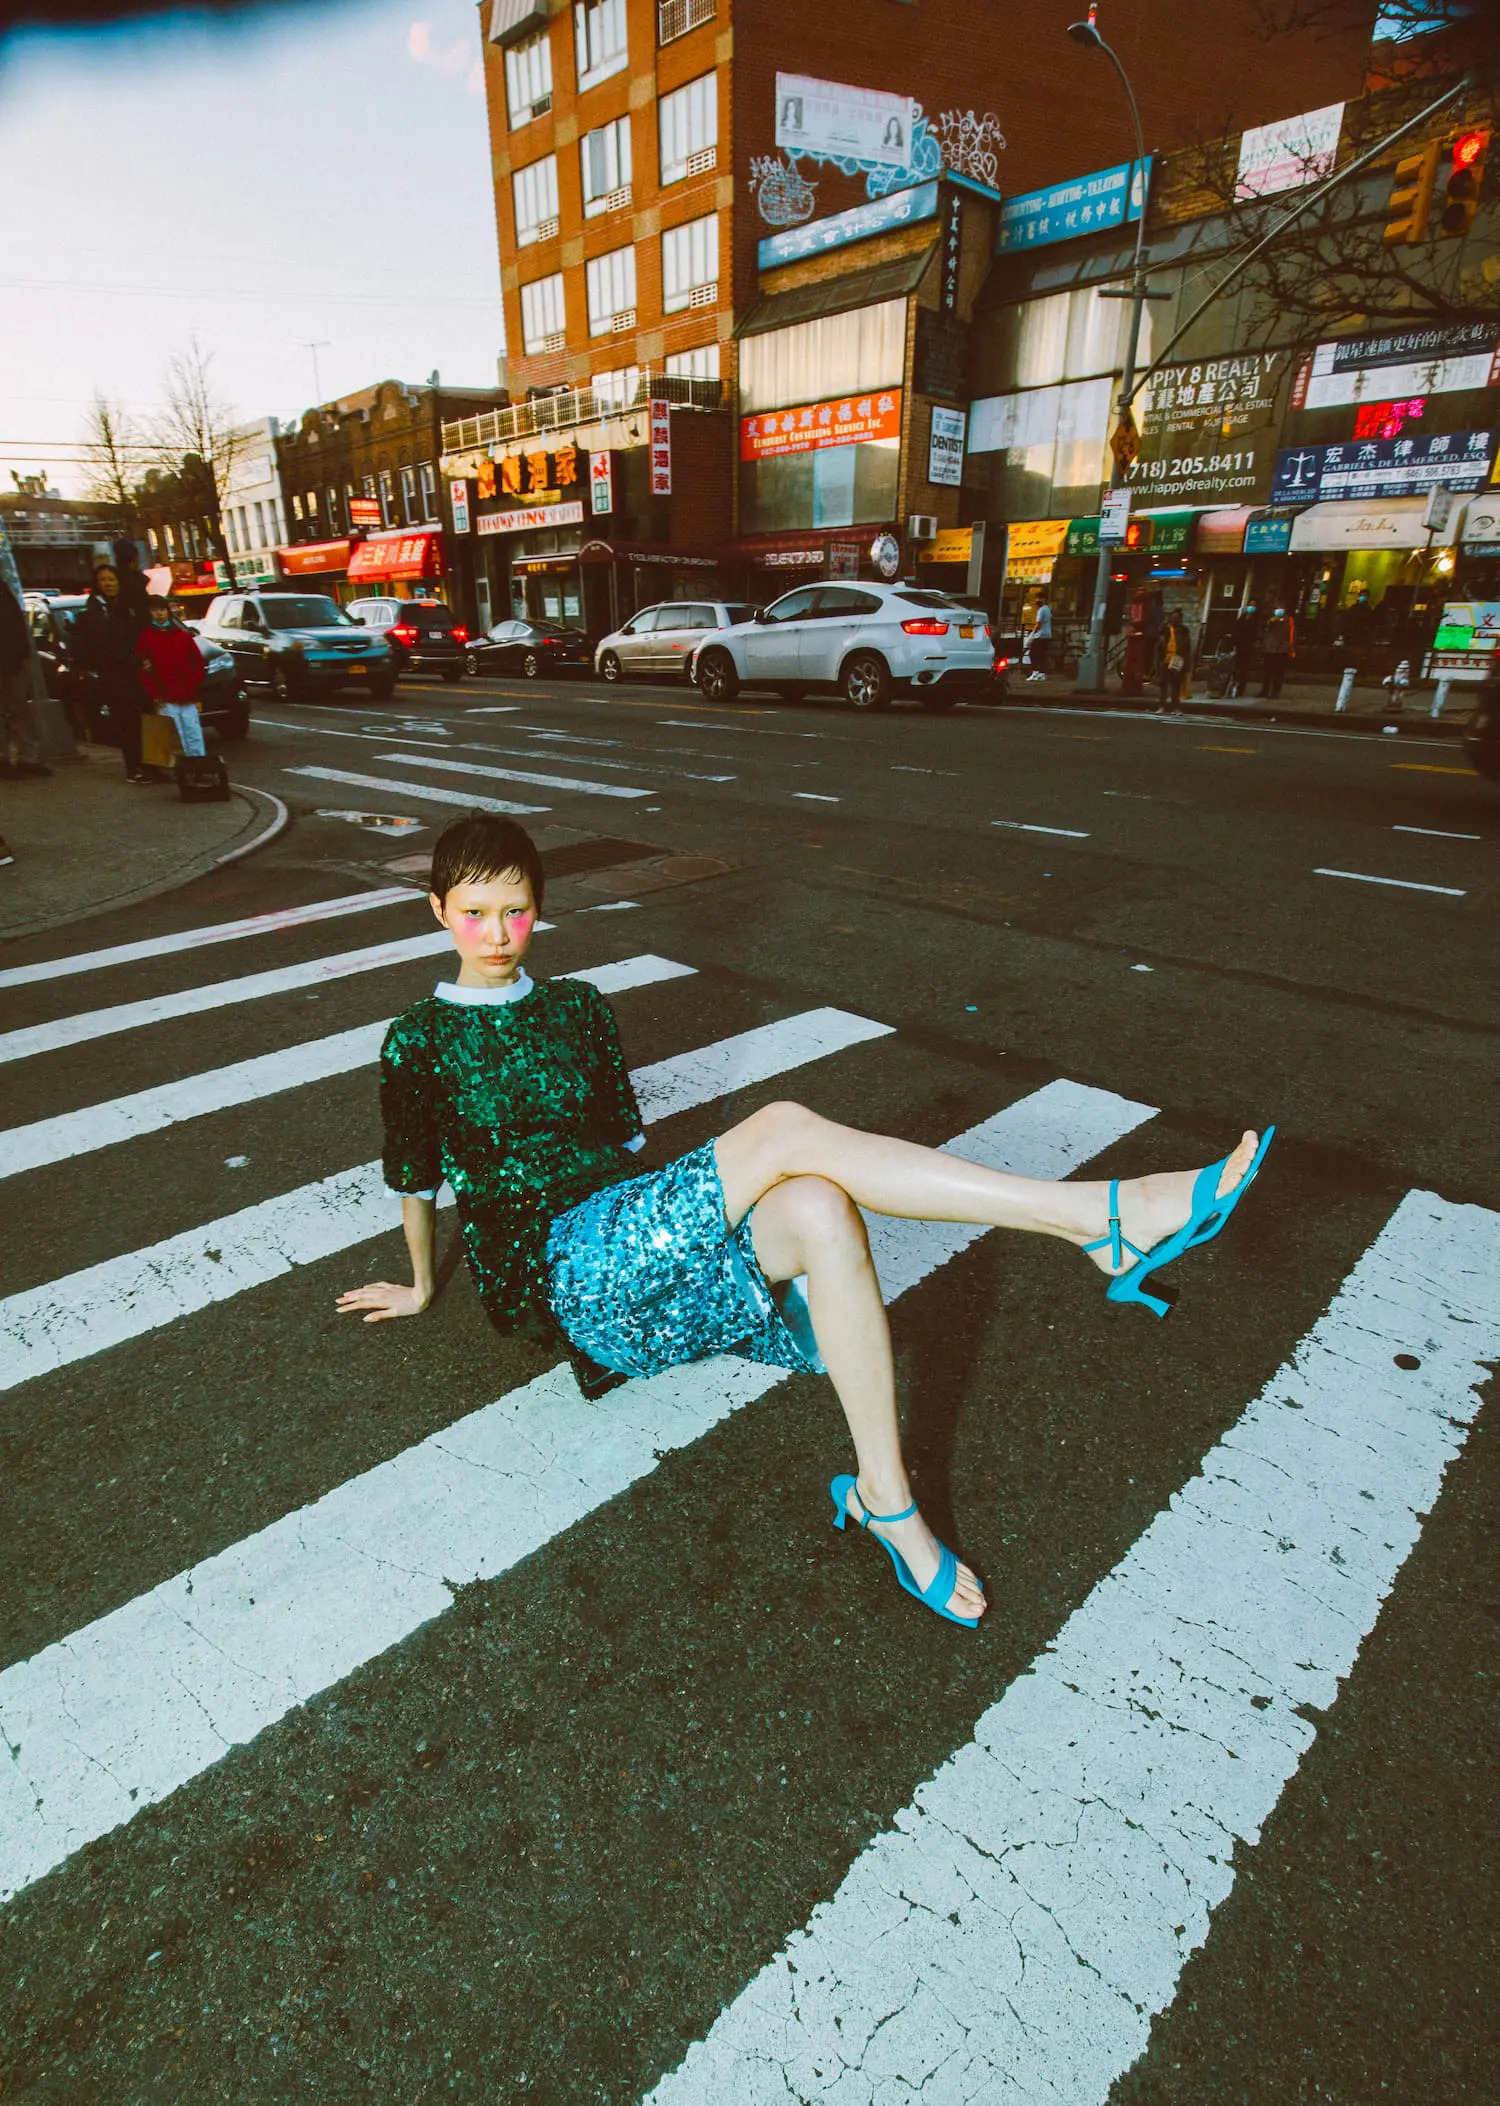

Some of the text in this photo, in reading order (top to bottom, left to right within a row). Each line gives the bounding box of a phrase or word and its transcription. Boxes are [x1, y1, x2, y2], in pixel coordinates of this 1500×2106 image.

[1146, 367, 1187, 390] APPY
[1189, 365, 1202, 384] 8
[931, 434, 963, 453] DENTIST
[1123, 451, 1256, 482] (718) 205.8411
[1322, 462, 1366, 473] GABRIEL
